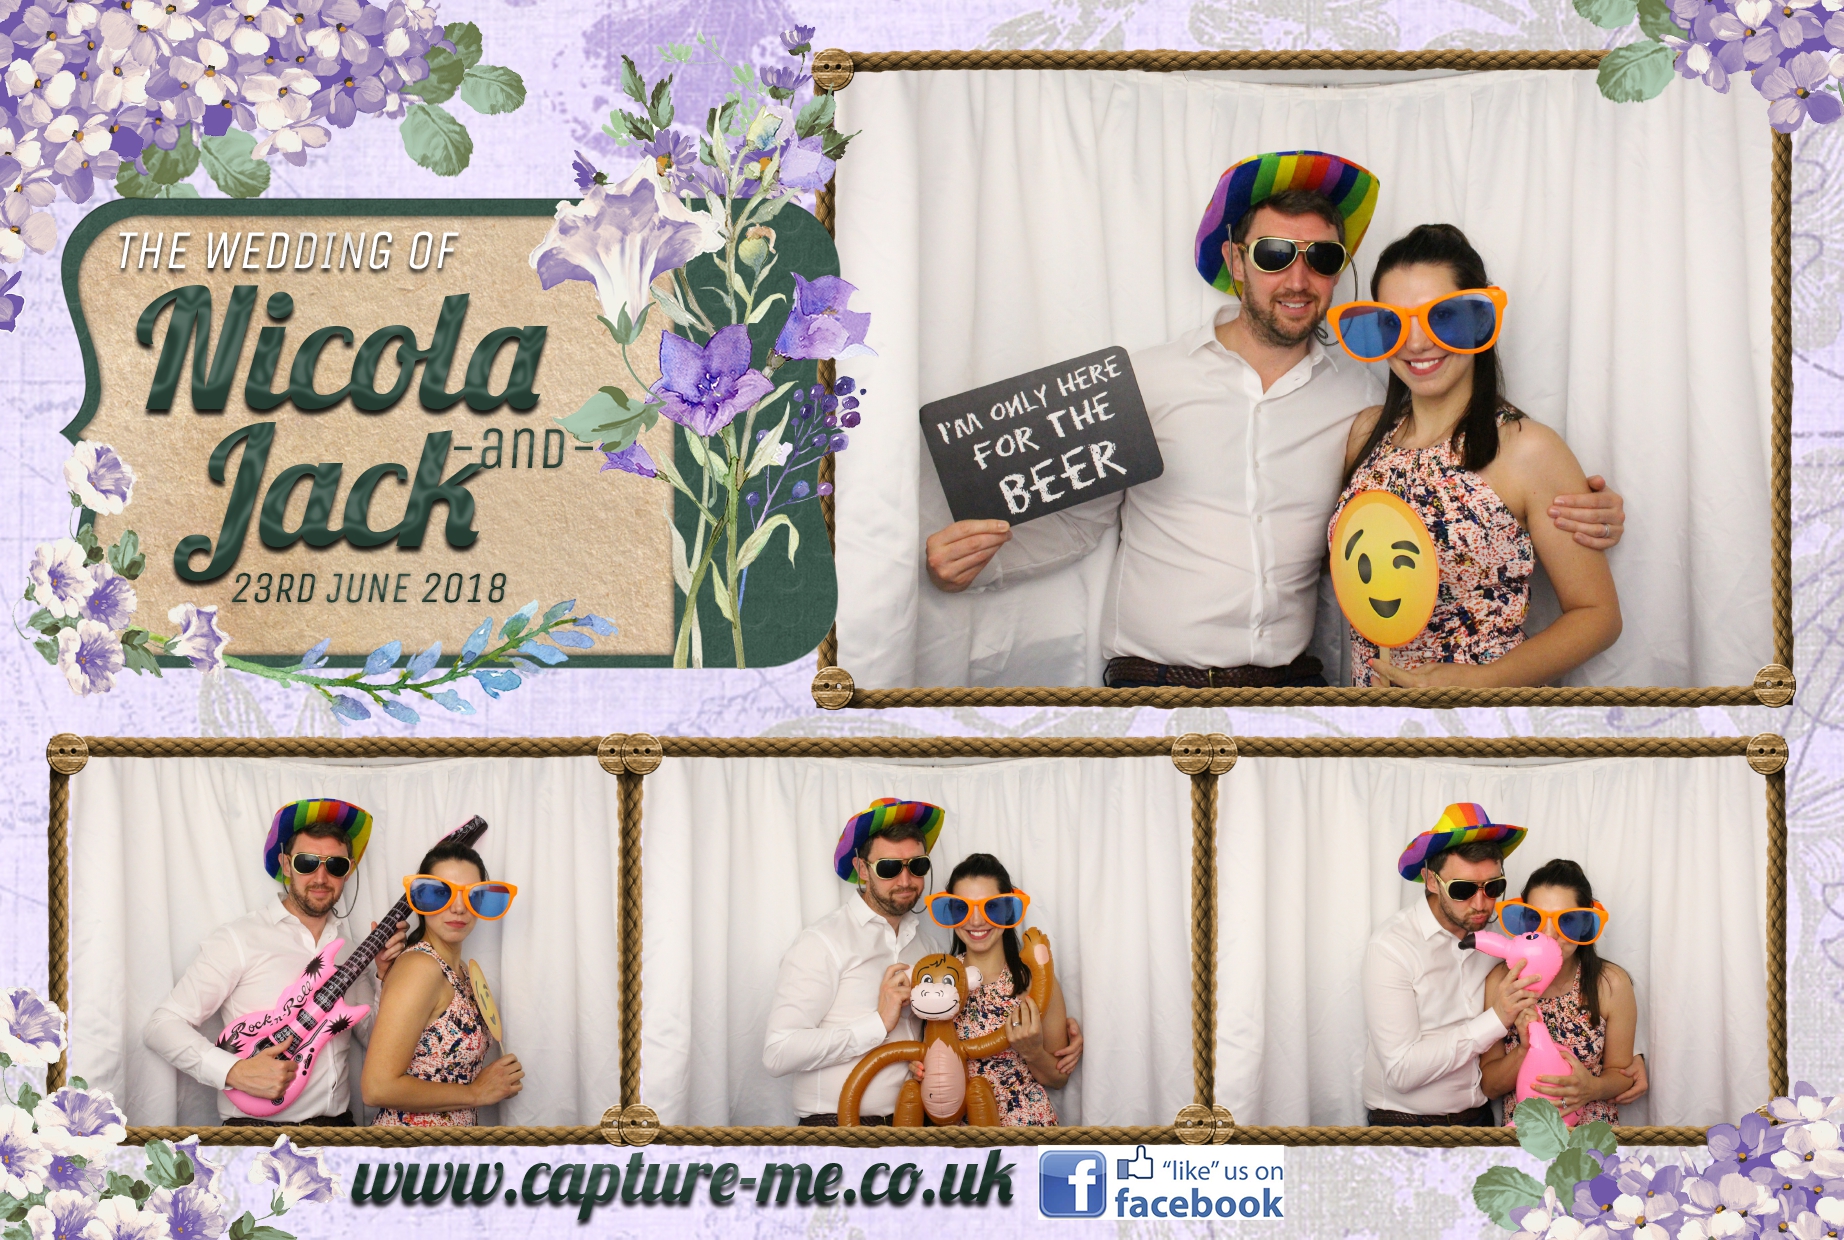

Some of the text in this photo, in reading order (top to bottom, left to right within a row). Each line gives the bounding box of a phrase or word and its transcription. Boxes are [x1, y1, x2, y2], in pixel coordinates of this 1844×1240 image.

[937, 355, 1122, 445] I'M ONLY HERE
[973, 391, 1115, 470] FOR THE
[999, 440, 1127, 515] BEER
